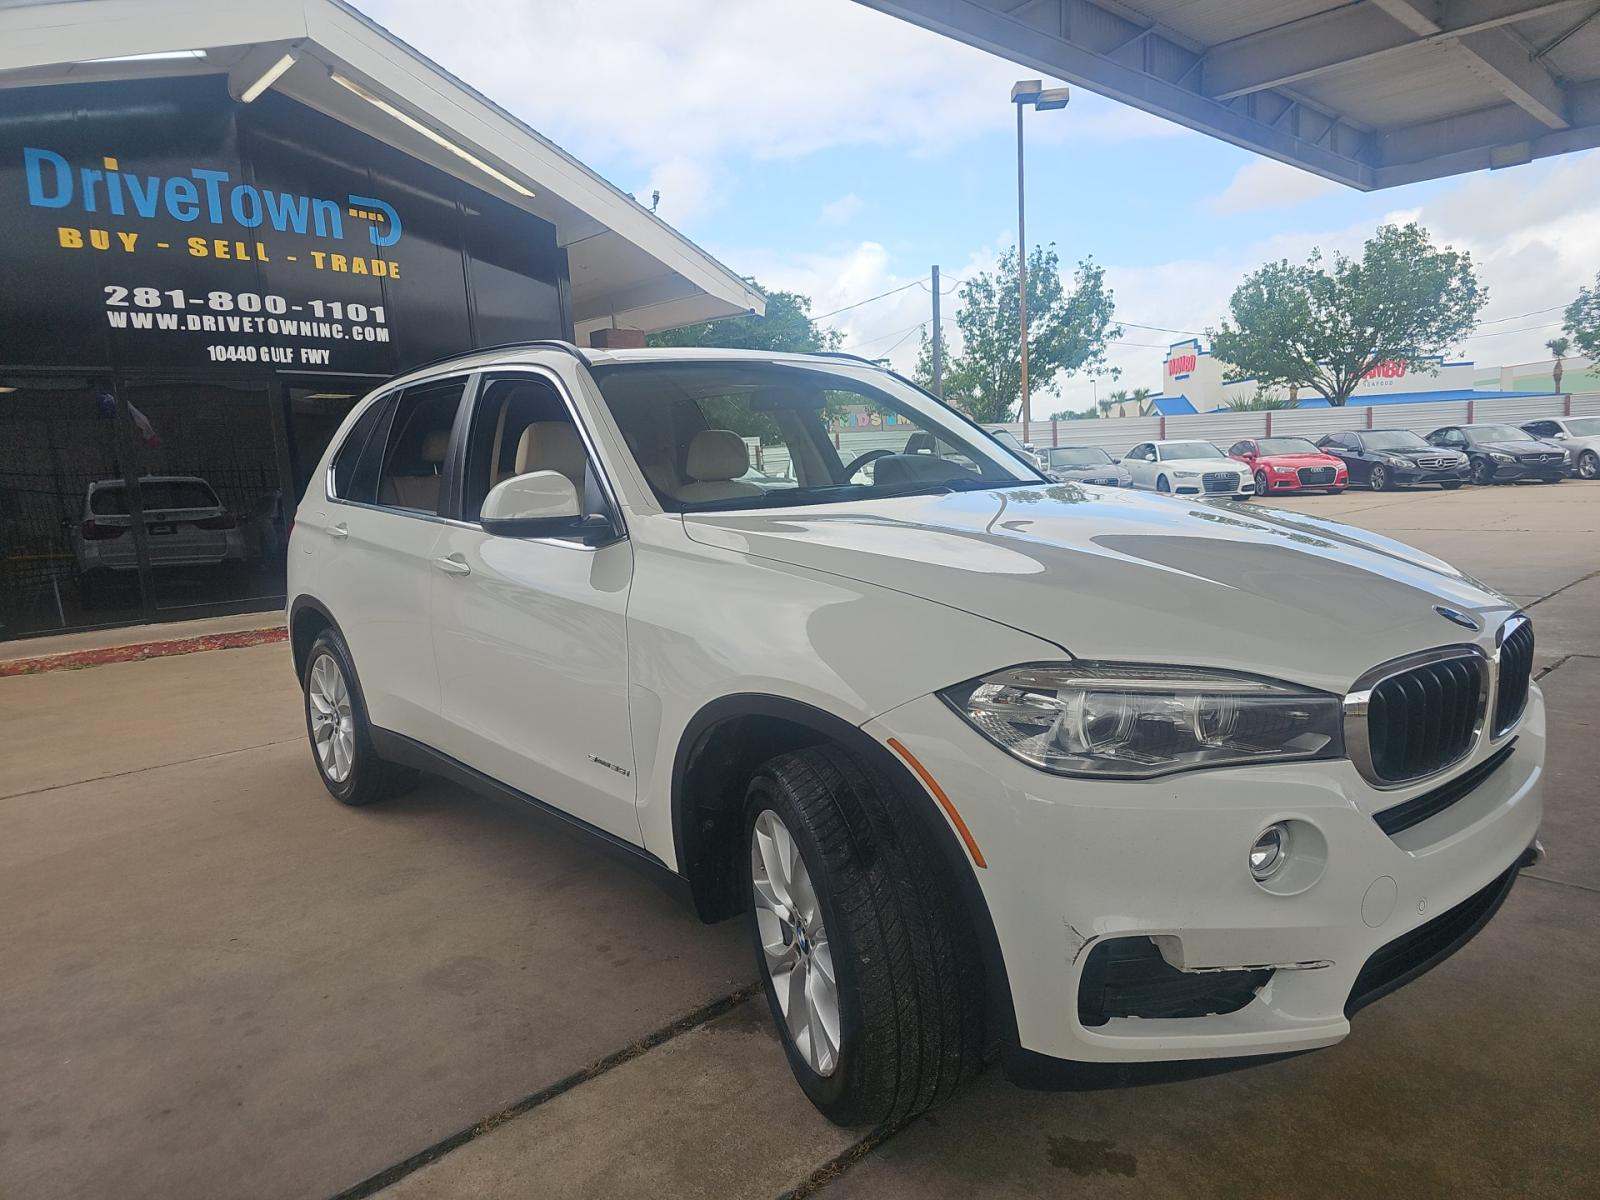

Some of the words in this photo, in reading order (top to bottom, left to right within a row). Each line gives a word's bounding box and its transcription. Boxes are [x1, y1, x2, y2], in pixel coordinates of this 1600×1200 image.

[23, 147, 345, 240] DriveTown
[57, 227, 138, 253] BUY
[187, 237, 270, 263] SELL
[310, 251, 401, 279] TRADE
[104, 285, 386, 324] 281-800-1101
[106, 310, 390, 343] WWW.DRIVETOWNINC.COM
[207, 345, 257, 362] 10440
[260, 346, 294, 363] GULF
[300, 348, 330, 365] FWY
